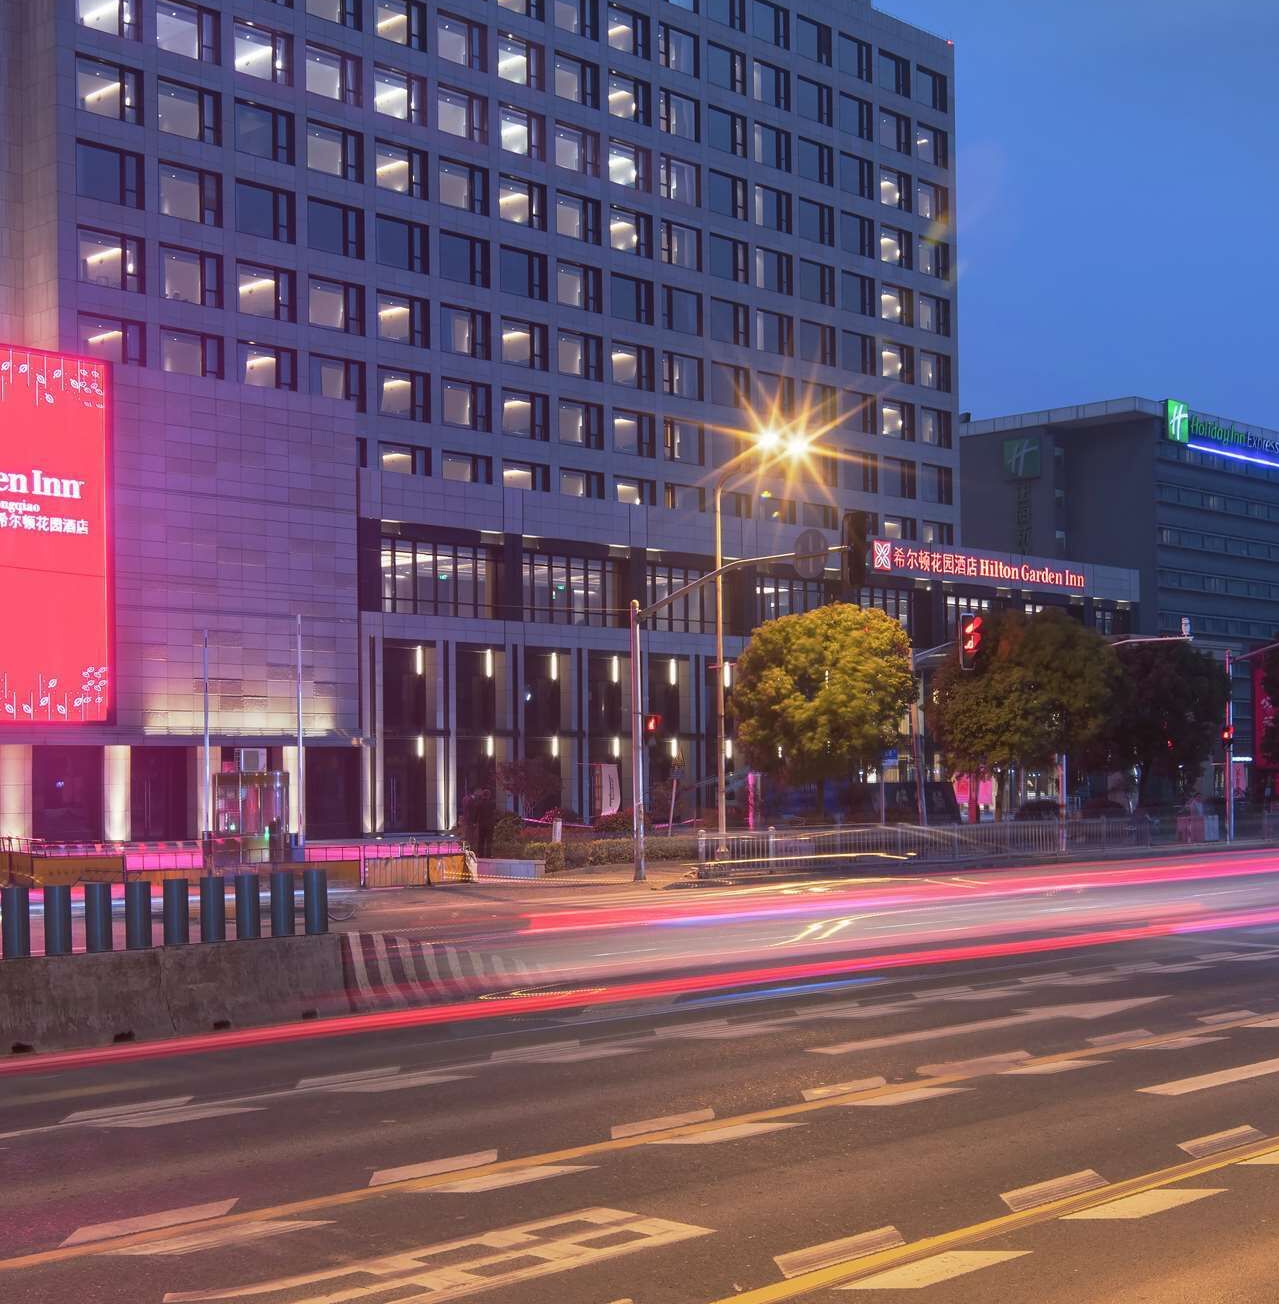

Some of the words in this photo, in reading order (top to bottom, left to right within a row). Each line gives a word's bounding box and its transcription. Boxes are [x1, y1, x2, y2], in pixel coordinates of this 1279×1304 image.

[1191, 416, 1230, 445] Holiday
[1231, 424, 1246, 444] Inn
[1248, 432, 1279, 454] Express
[31, 470, 82, 499] Inn
[893, 547, 977, 577] 希尔顿花园酒店
[979, 560, 1019, 580] Hilton
[1021, 564, 1063, 585] Garden
[1065, 569, 1085, 588] Inn
